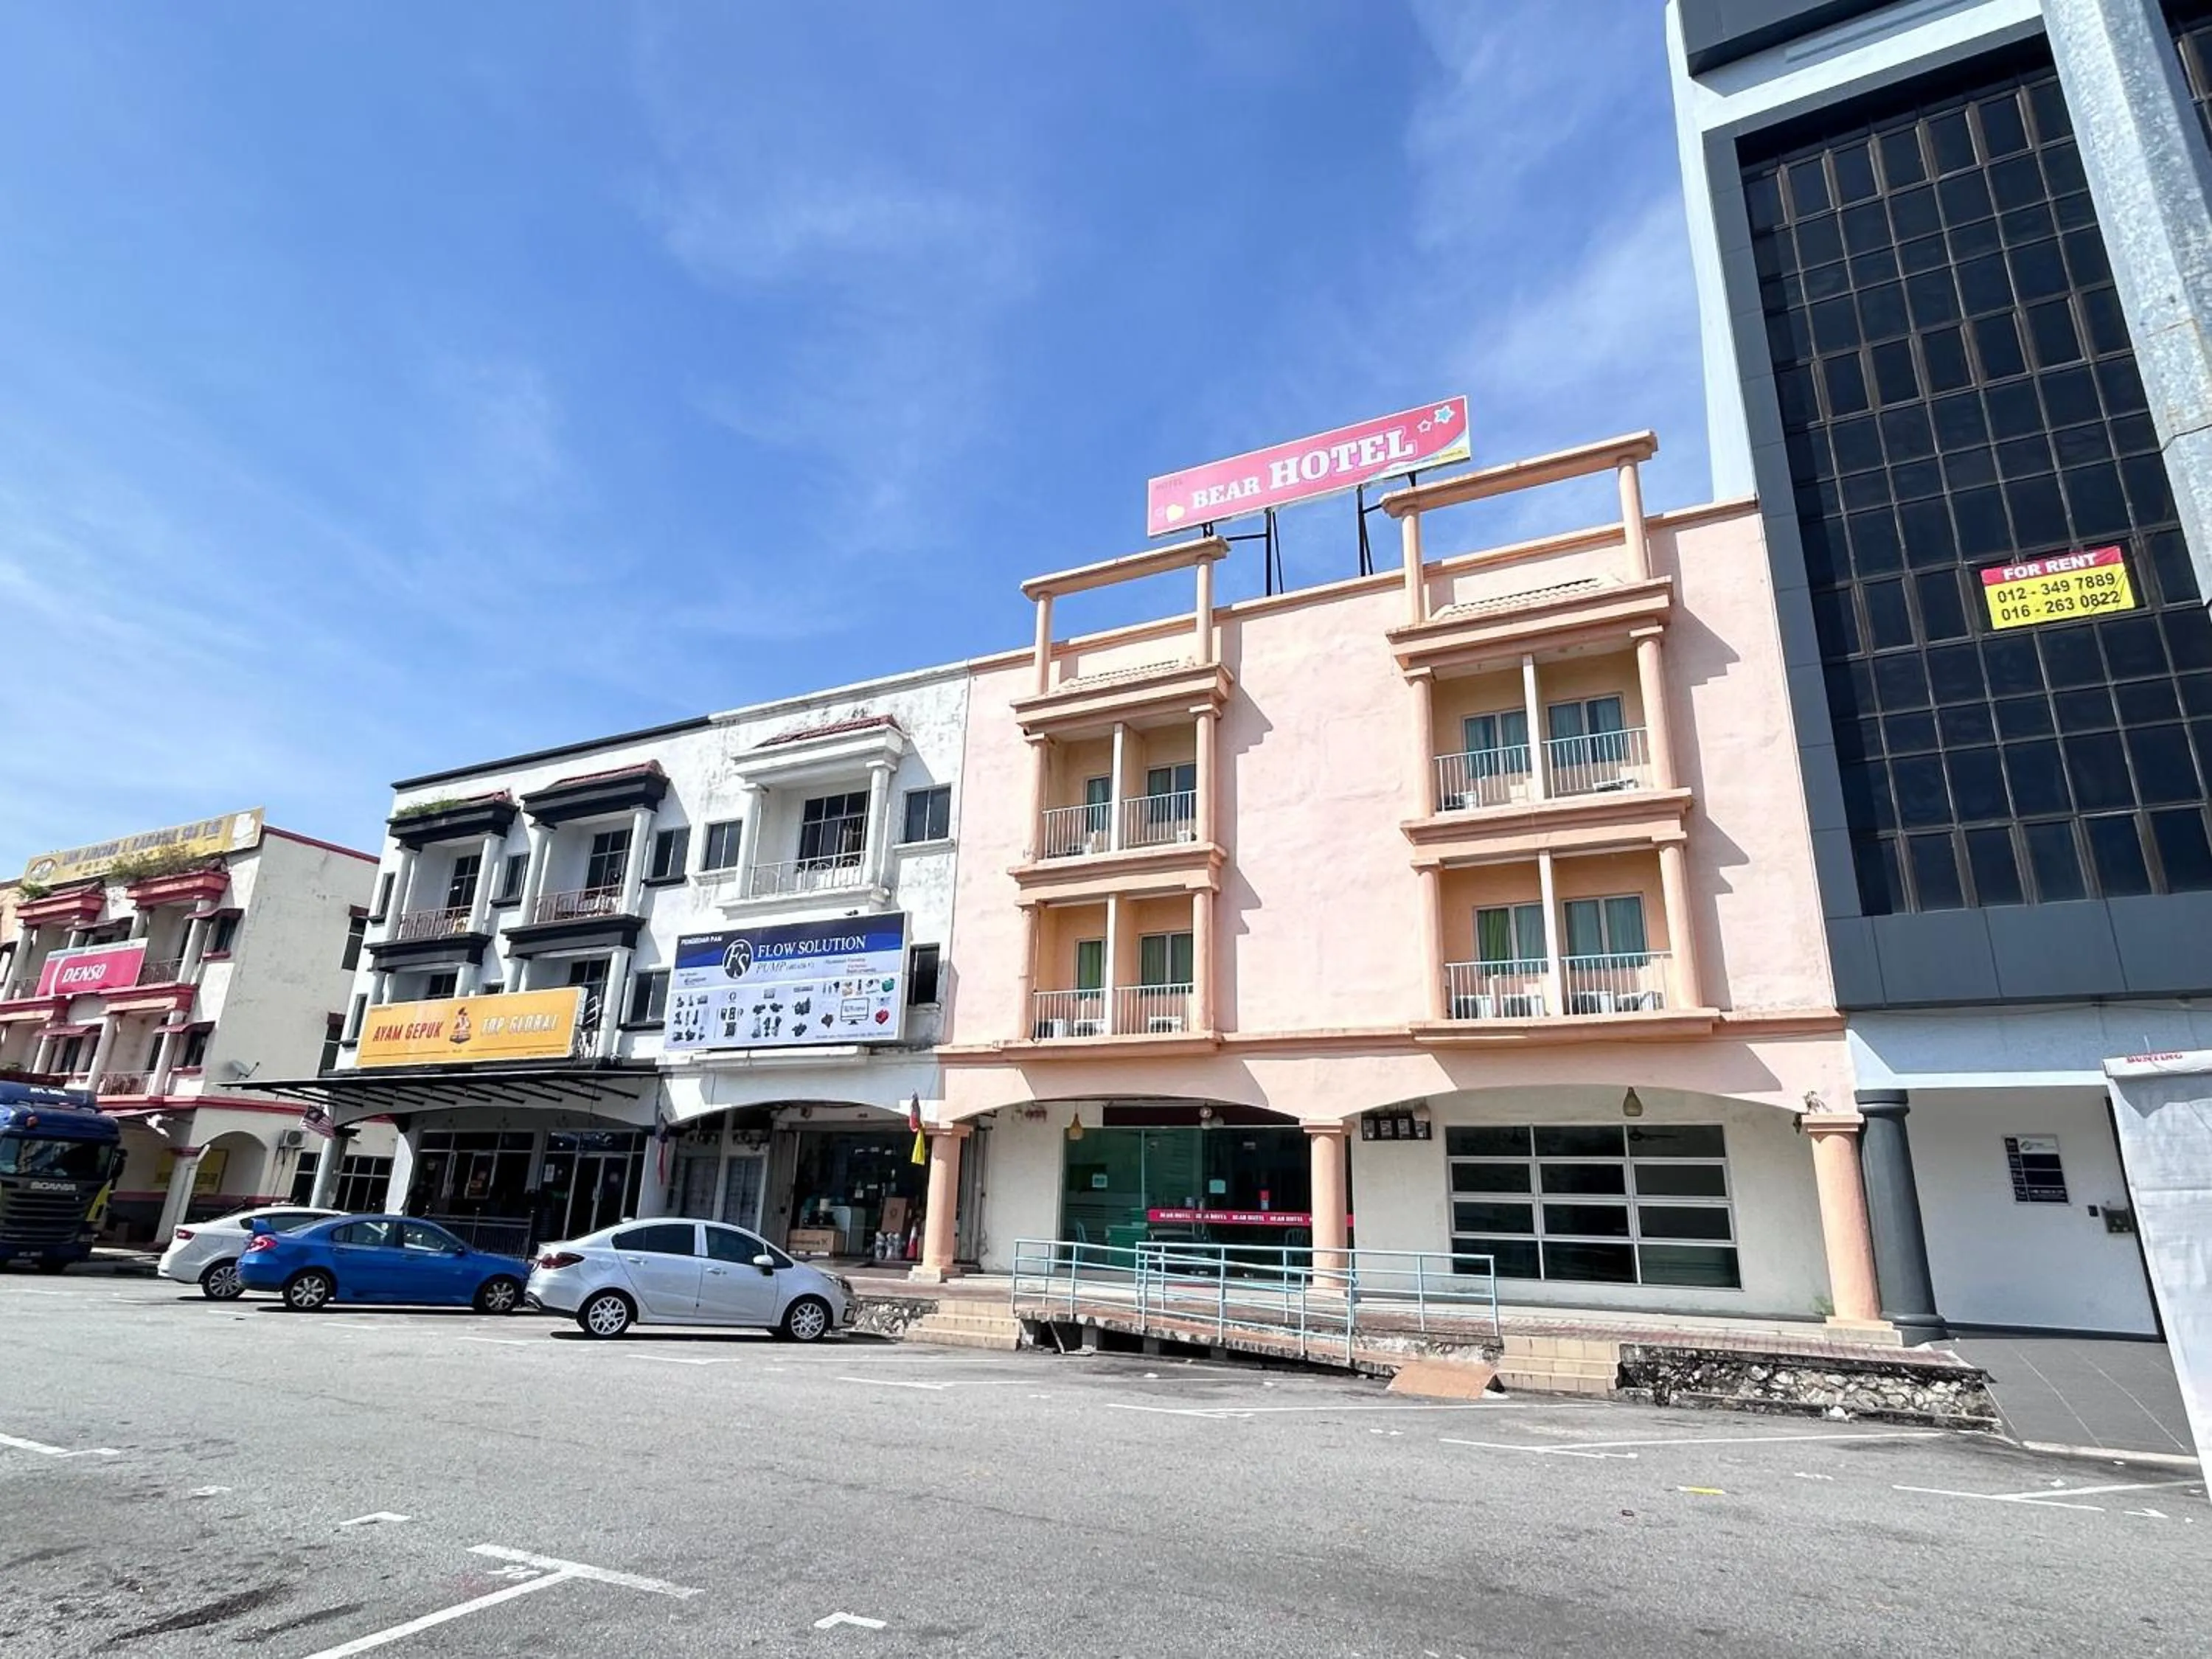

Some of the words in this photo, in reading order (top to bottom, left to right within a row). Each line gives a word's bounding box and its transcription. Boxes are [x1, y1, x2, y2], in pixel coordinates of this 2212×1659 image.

[1192, 476, 1262, 509] BEAR
[1269, 428, 1415, 491] HOTEL
[2003, 563, 2042, 581] FOR
[2047, 553, 2097, 574] RENT
[1997, 587, 2028, 603] 012
[2040, 580, 2070, 596] 349
[2075, 572, 2115, 590] 7889
[2001, 605, 2031, 622] 016
[2045, 597, 2075, 613] 263
[2080, 590, 2121, 608] 0822
[726, 943, 750, 978] FS
[757, 942, 797, 958] FLOW
[798, 934, 866, 955] SOLUTION
[62, 963, 107, 983] DENSO
[372, 1023, 404, 1042] AYAM
[405, 1021, 444, 1040] GEPUK
